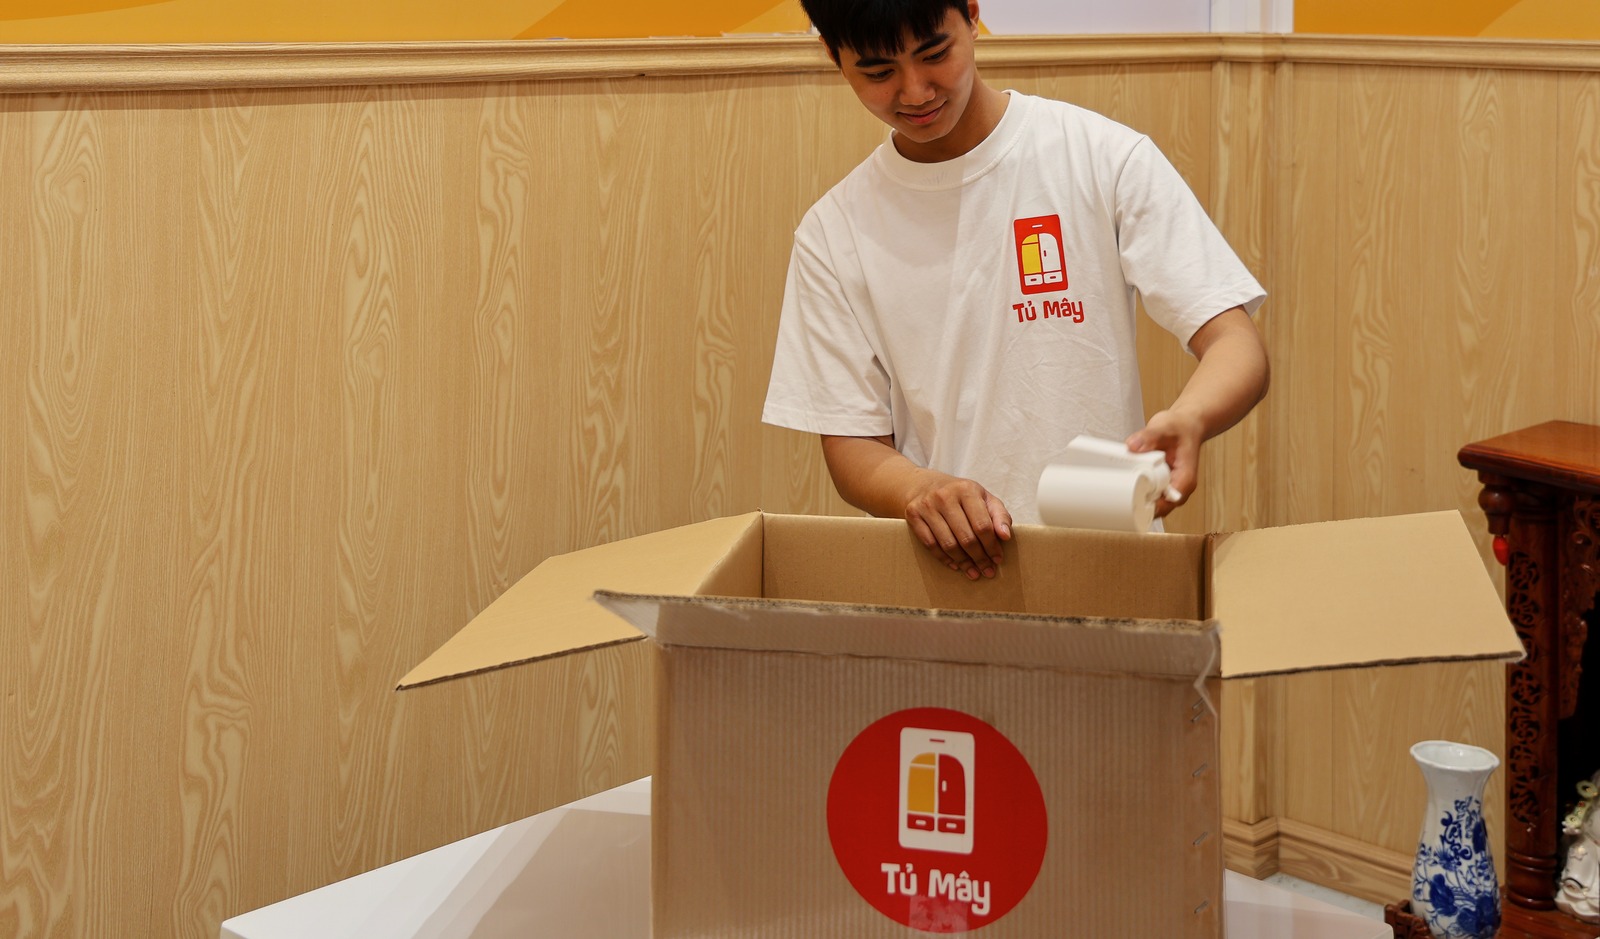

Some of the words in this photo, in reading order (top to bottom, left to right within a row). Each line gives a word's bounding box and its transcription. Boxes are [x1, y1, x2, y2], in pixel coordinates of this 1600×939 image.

[1012, 300, 1037, 323] Tủ
[1042, 297, 1085, 323] Mây
[880, 862, 918, 896] Tủ
[927, 869, 991, 916] Mây
